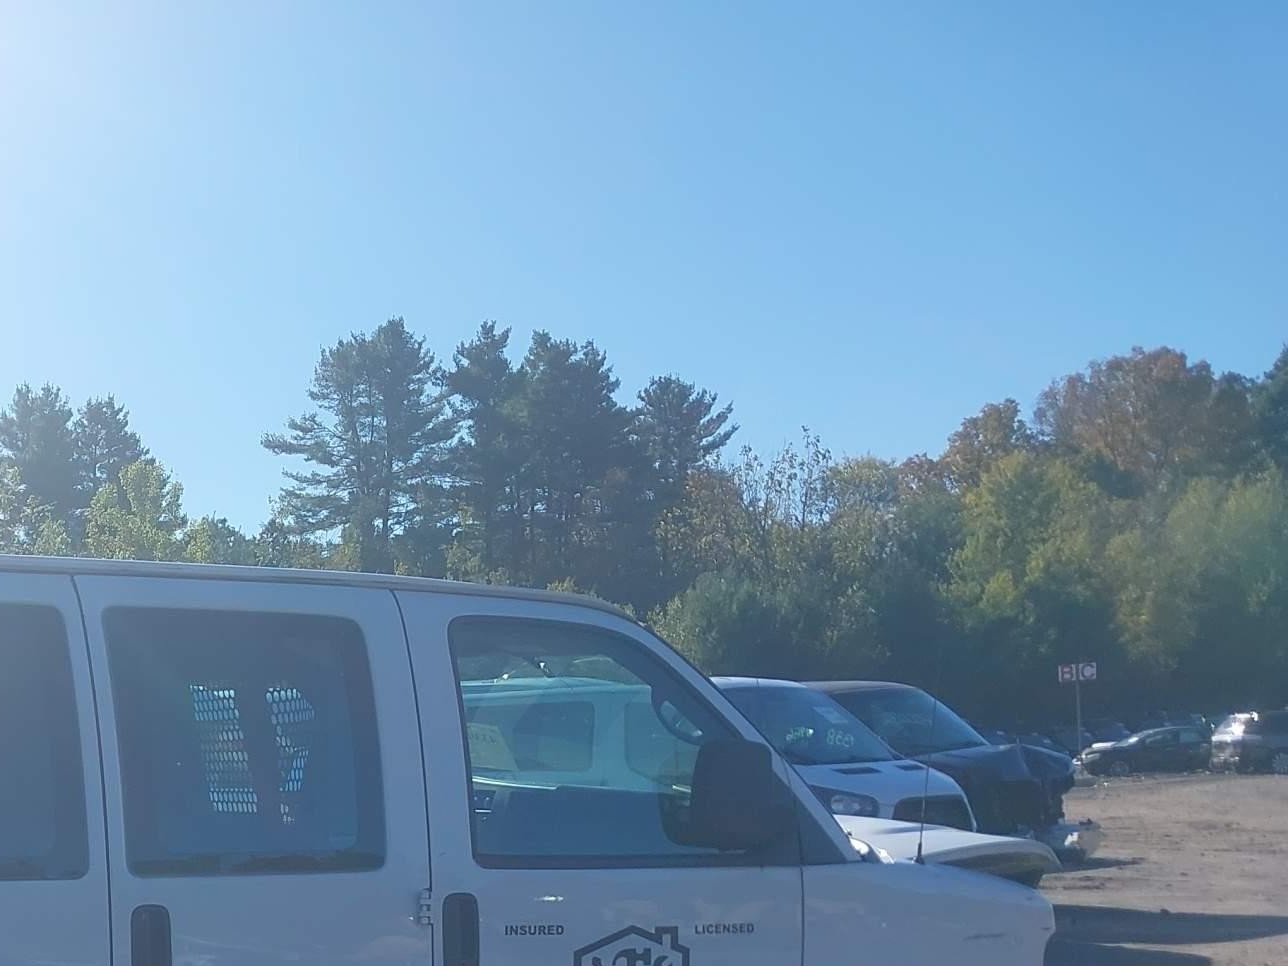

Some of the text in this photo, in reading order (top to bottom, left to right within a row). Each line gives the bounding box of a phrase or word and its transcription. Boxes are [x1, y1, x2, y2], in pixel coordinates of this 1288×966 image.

[1080, 663, 1096, 679] C
[504, 925, 565, 936] INSURED
[694, 923, 755, 935] LICENSED
